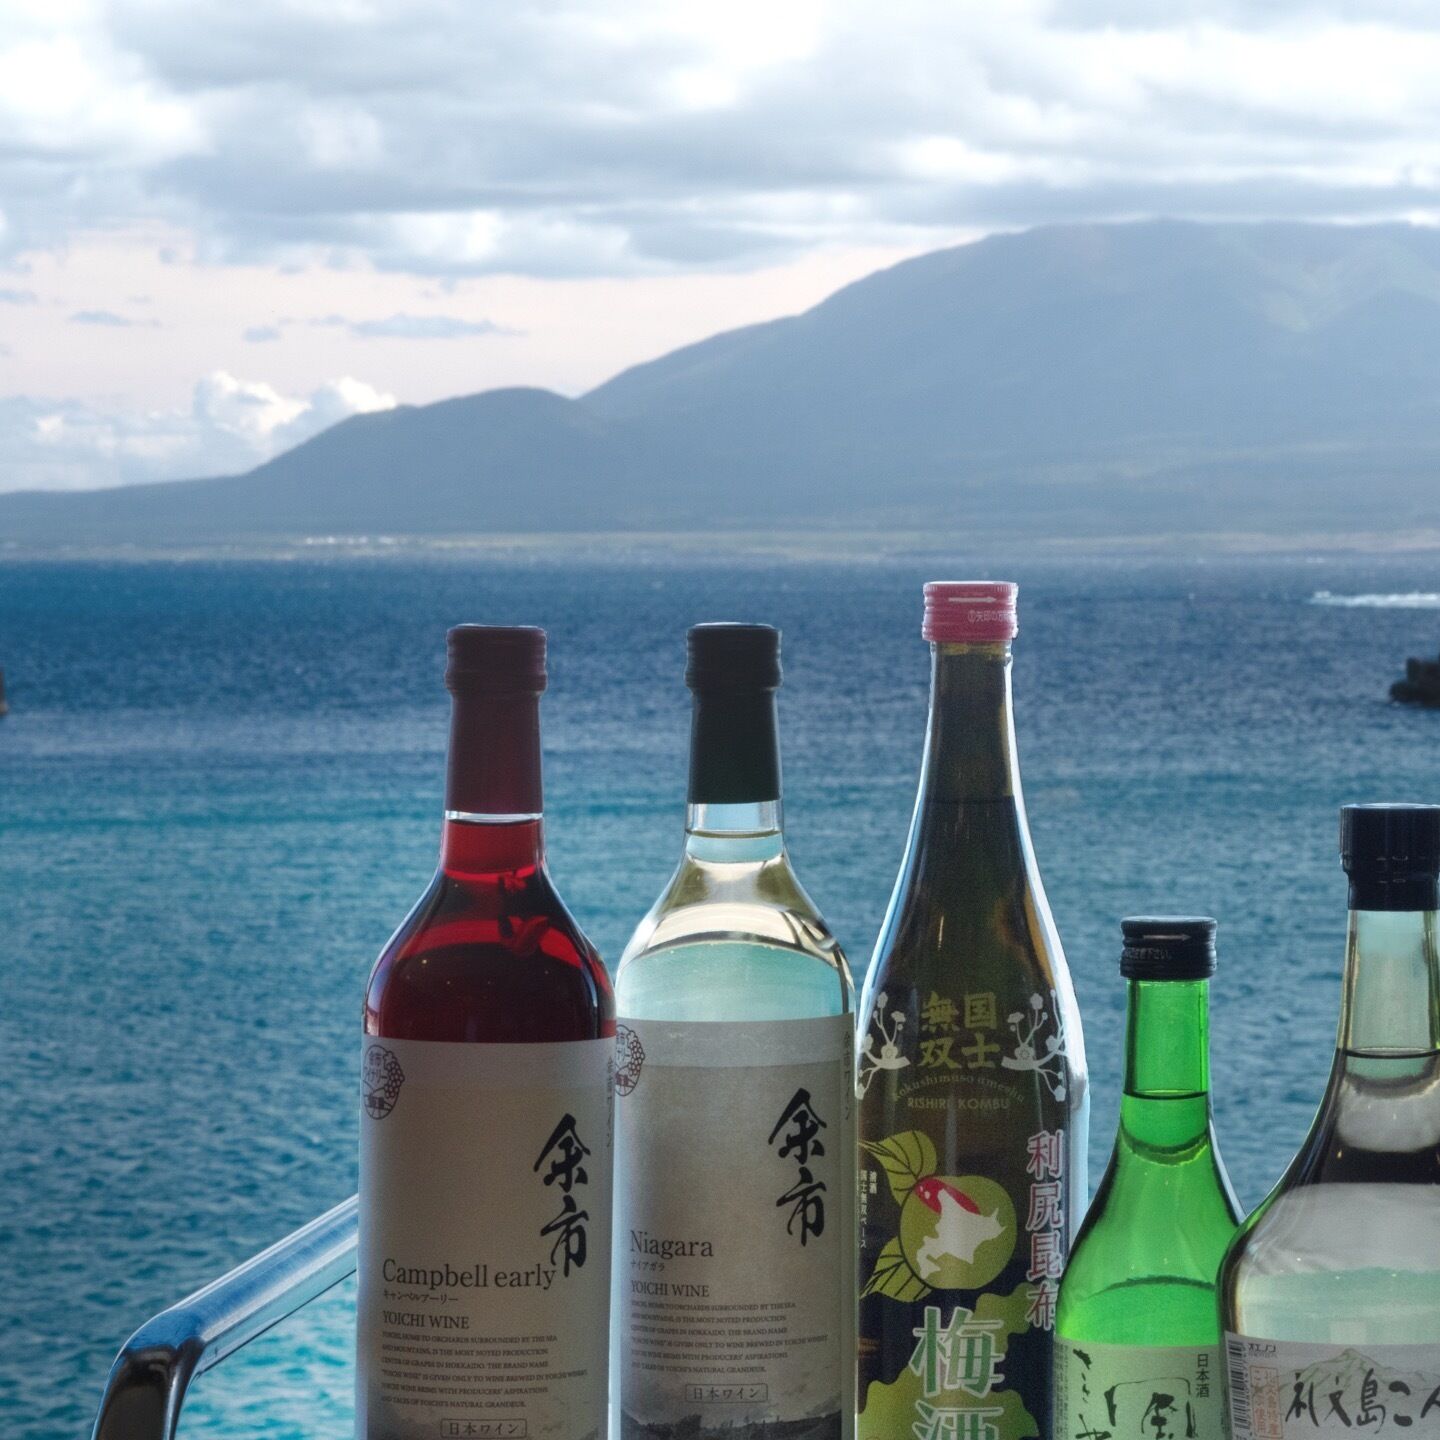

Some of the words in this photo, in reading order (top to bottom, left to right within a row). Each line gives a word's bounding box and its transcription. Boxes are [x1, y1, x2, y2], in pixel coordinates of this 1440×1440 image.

[958, 1099, 1010, 1110] KOMBU
[768, 1087, 827, 1248] 余市
[533, 1113, 592, 1278] 余市
[630, 1229, 714, 1260] Niagara
[1025, 1129, 1065, 1331] 利尻昆布
[383, 1258, 488, 1291] Campbell
[494, 1263, 557, 1290] early
[631, 1280, 669, 1297] YOICHI
[672, 1284, 710, 1298] WINE
[382, 1311, 425, 1328] YOICHI
[429, 1315, 470, 1329] WINE
[1196, 1353, 1210, 1398] 日本酒
[694, 1387, 760, 1400] 日本ワイン
[449, 1422, 519, 1435] 日本ワイン
